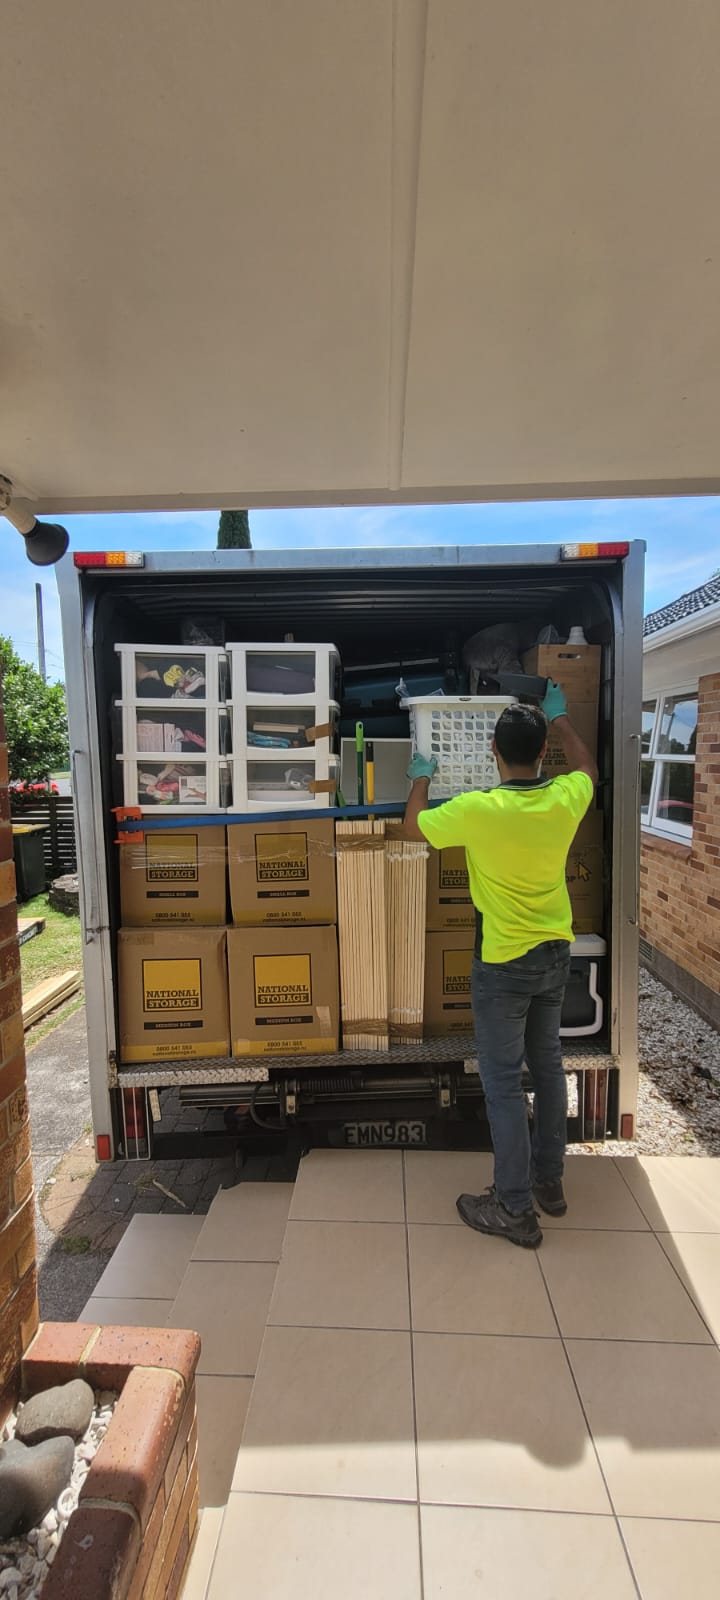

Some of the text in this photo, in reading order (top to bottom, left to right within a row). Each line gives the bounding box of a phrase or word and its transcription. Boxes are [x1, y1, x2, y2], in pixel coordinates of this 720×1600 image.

[259, 861, 305, 869] NATIONAL
[151, 870, 194, 878] STORAGE
[261, 869, 304, 878] STORAGE
[447, 975, 472, 983] NATIO
[146, 989, 199, 998] NATIONAL
[257, 984, 309, 994] NATIONAL
[260, 994, 307, 1003] STORAGE
[148, 999, 197, 1008] STORAGE
[344, 1124, 425, 1145] EMN983
